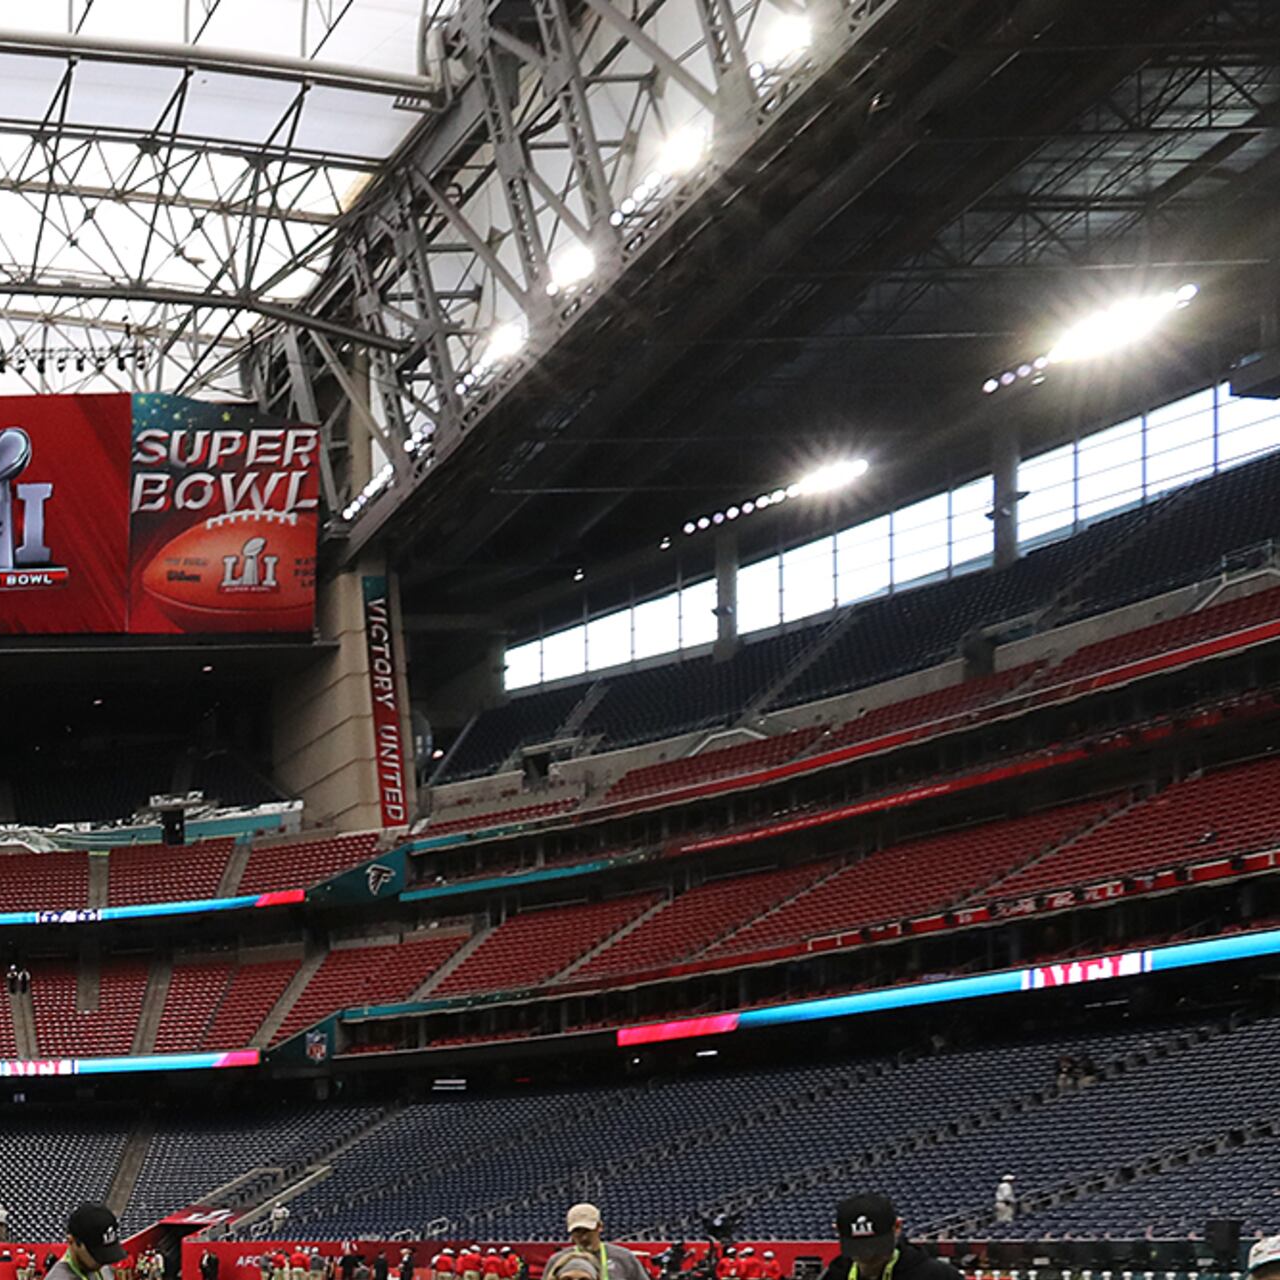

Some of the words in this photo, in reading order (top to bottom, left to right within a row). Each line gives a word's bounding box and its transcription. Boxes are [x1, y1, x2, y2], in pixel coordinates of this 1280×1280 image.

[132, 428, 319, 469] SUPER
[131, 470, 319, 514] BOWL
[6, 573, 53, 586] BOWL
[367, 597, 396, 711] VICTORY
[379, 724, 404, 821] UNITED
